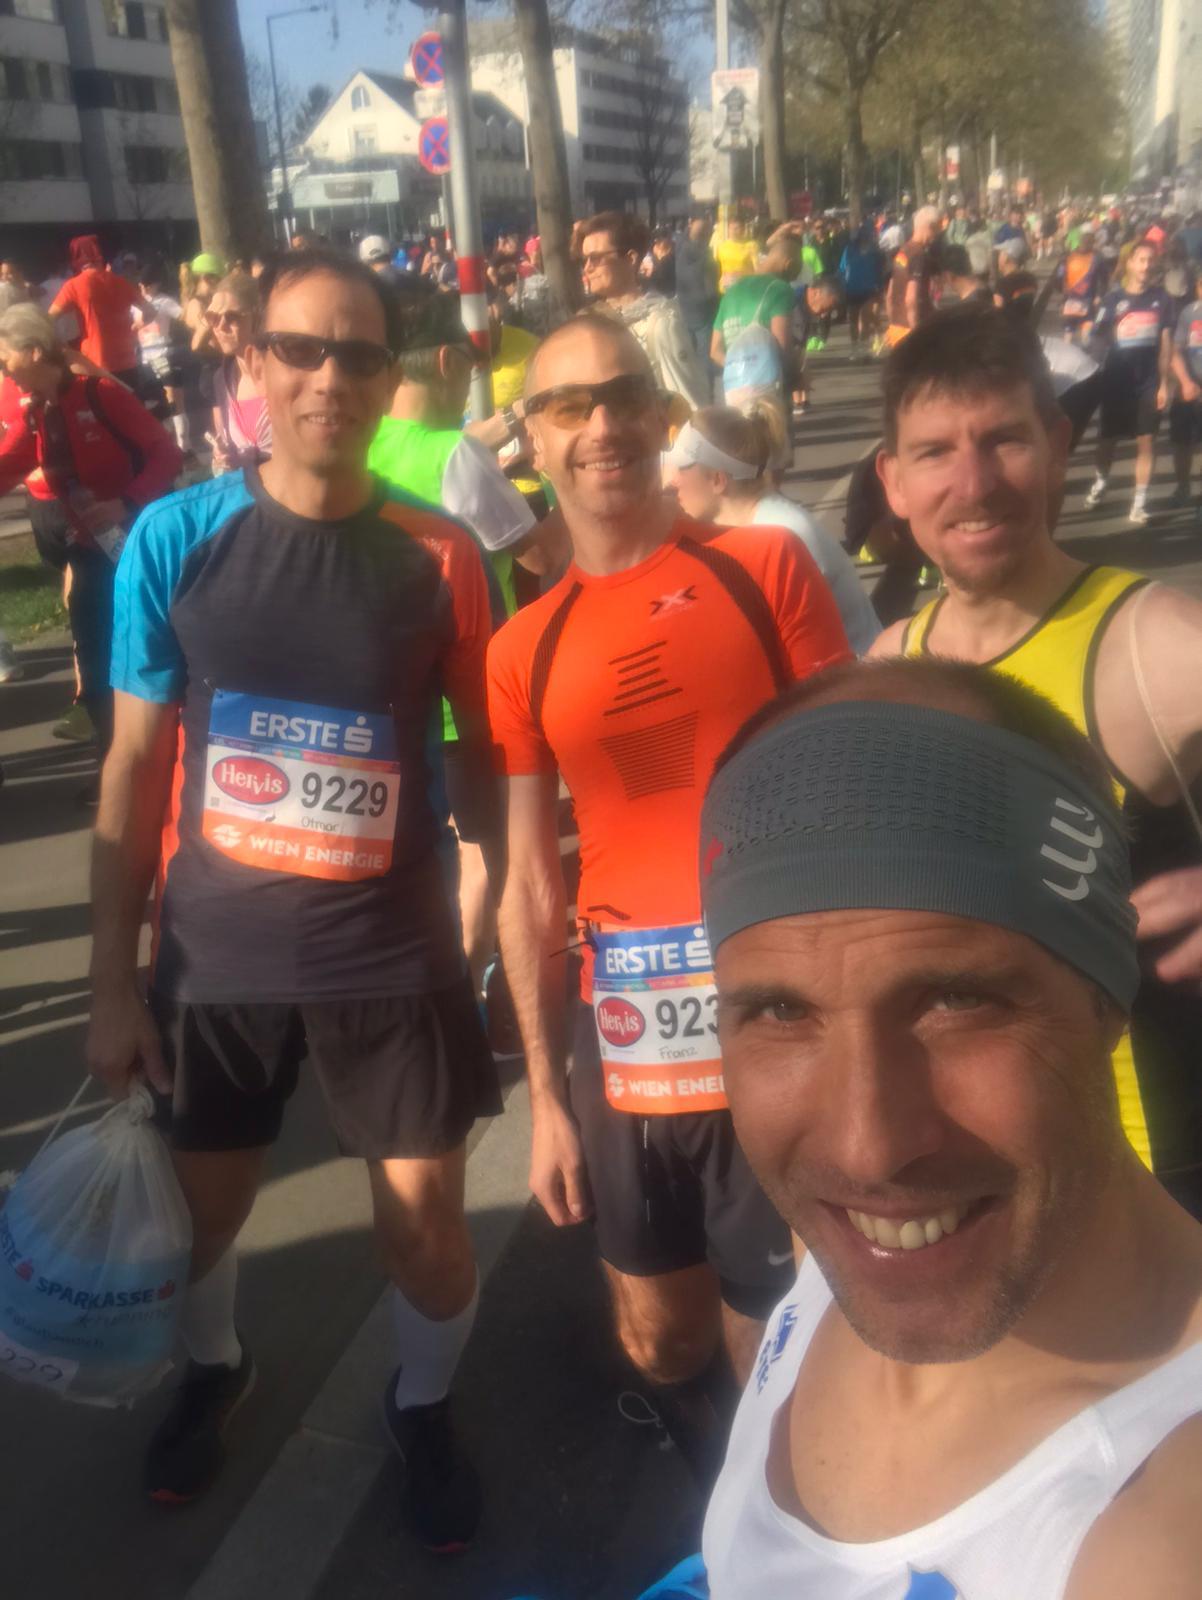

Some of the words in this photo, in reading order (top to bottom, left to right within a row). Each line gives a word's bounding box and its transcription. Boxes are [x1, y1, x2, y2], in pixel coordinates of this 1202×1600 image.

[250, 711, 340, 748] ERSTE
[220, 763, 283, 795] Hervis
[301, 772, 388, 818] 9229
[250, 835, 299, 859] WIEN
[304, 846, 385, 869] ENERGIE
[606, 943, 681, 974] ERSTE
[599, 1007, 641, 1036] Hervis
[659, 1045, 699, 1061] Franz
[628, 1078, 672, 1097] WIEN
[35, 1276, 155, 1310] SPARKASSE
